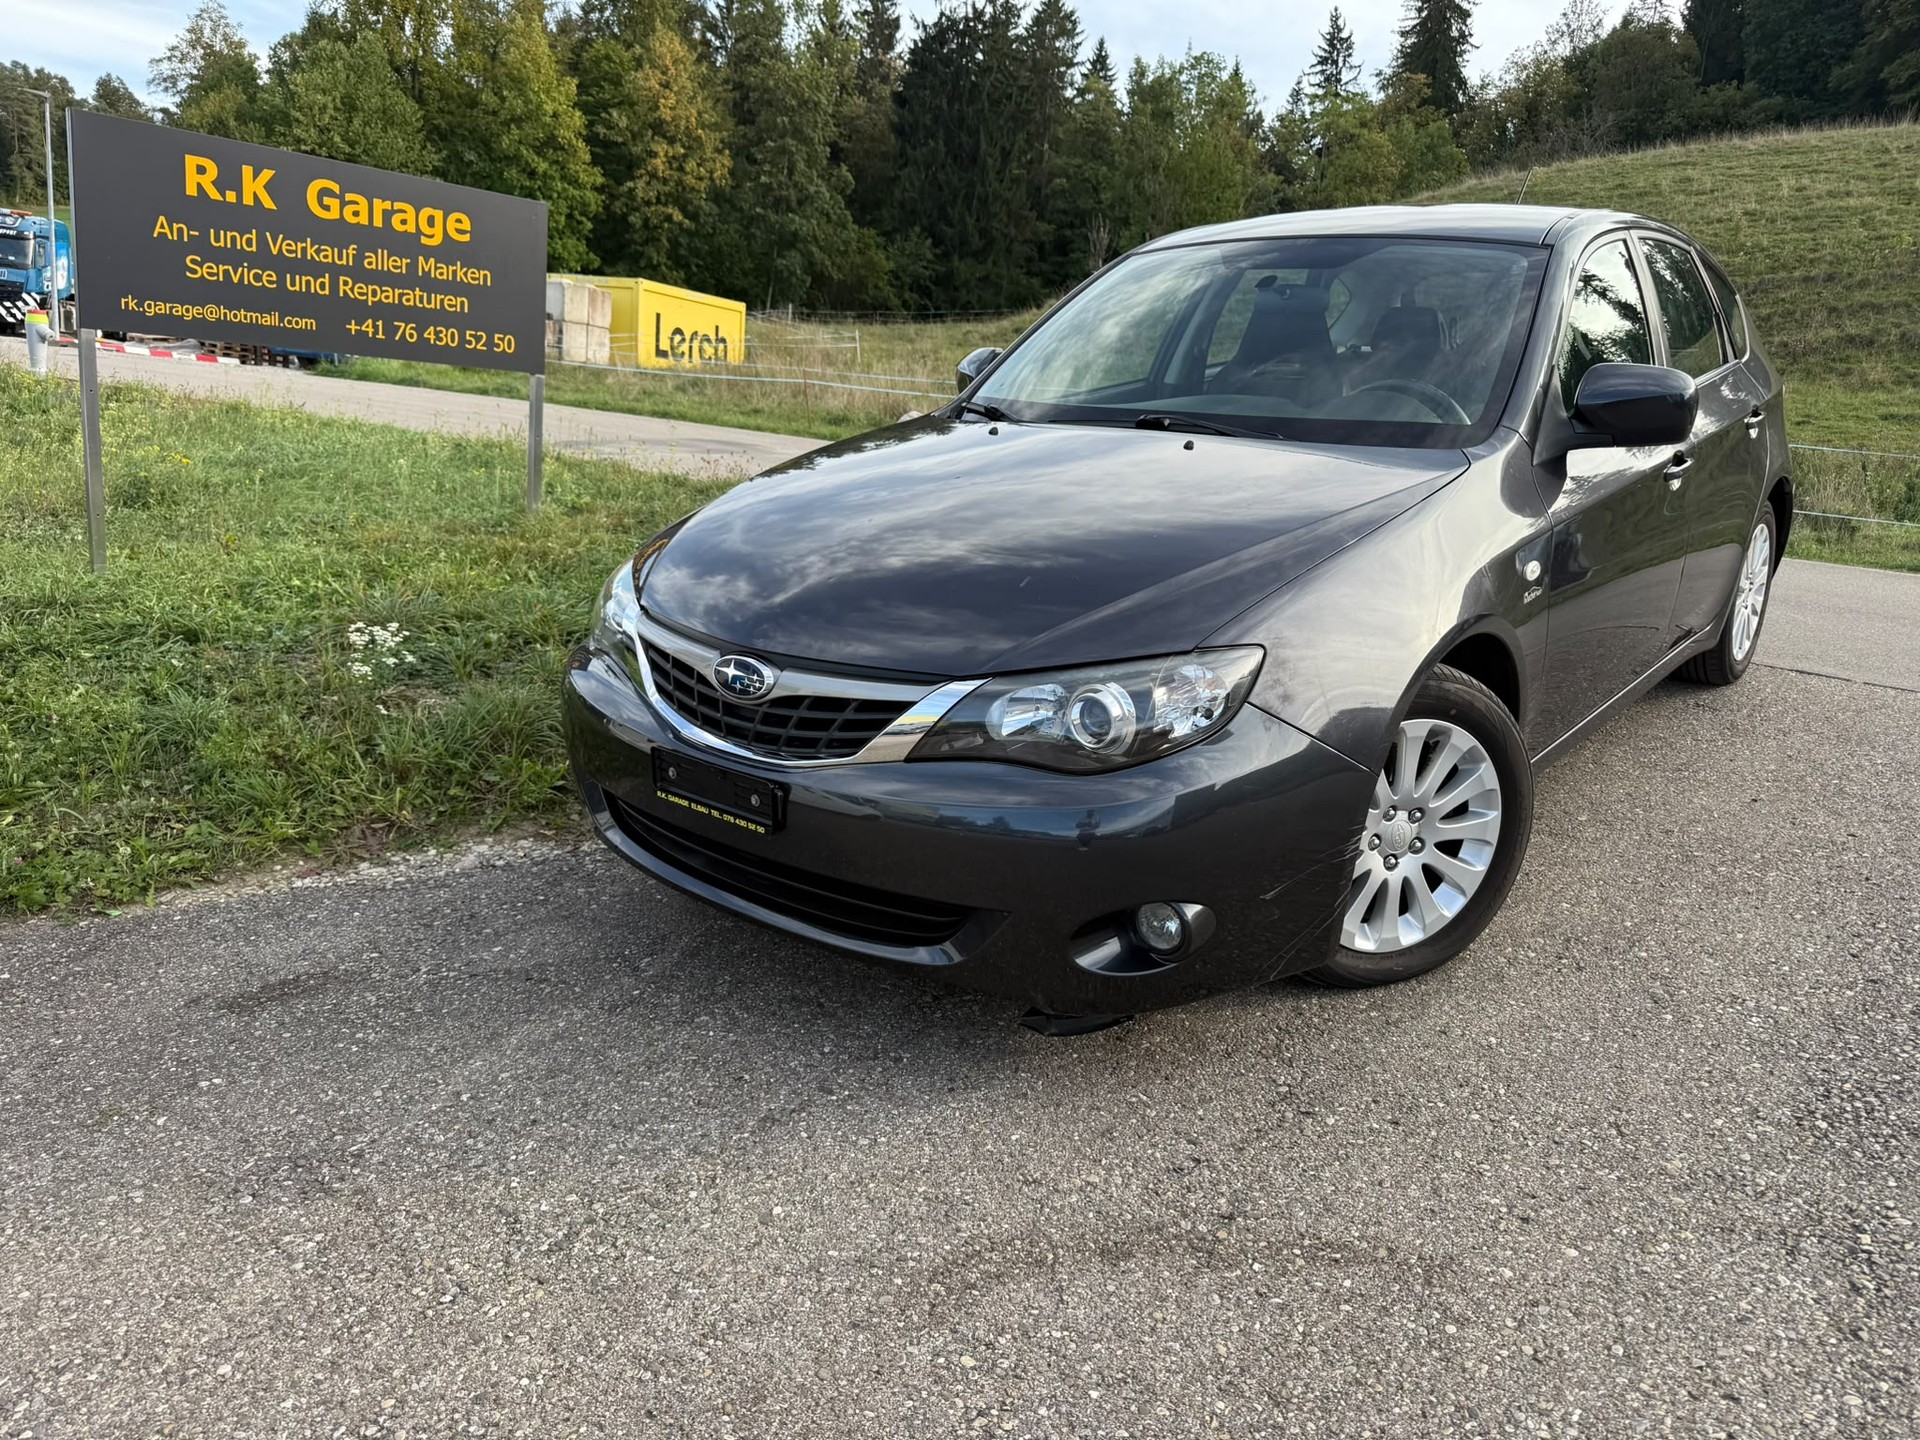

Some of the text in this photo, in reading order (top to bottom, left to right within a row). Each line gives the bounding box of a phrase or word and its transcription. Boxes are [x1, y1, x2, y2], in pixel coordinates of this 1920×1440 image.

[184, 153, 472, 247] R.K Garage
[153, 215, 492, 287] An- und Verkauf aller Marken
[185, 254, 469, 313] Service und Reparaturen
[121, 295, 316, 331] rk.garage@hotmail.com
[346, 319, 516, 354] +41 76 430 52 50
[655, 312, 728, 363] Lerch
[667, 795, 690, 808] GARAGE
[710, 809, 722, 819] TEL.
[735, 818, 747, 828] 430
[747, 822, 756, 831] 52
[756, 825, 765, 834] 50
